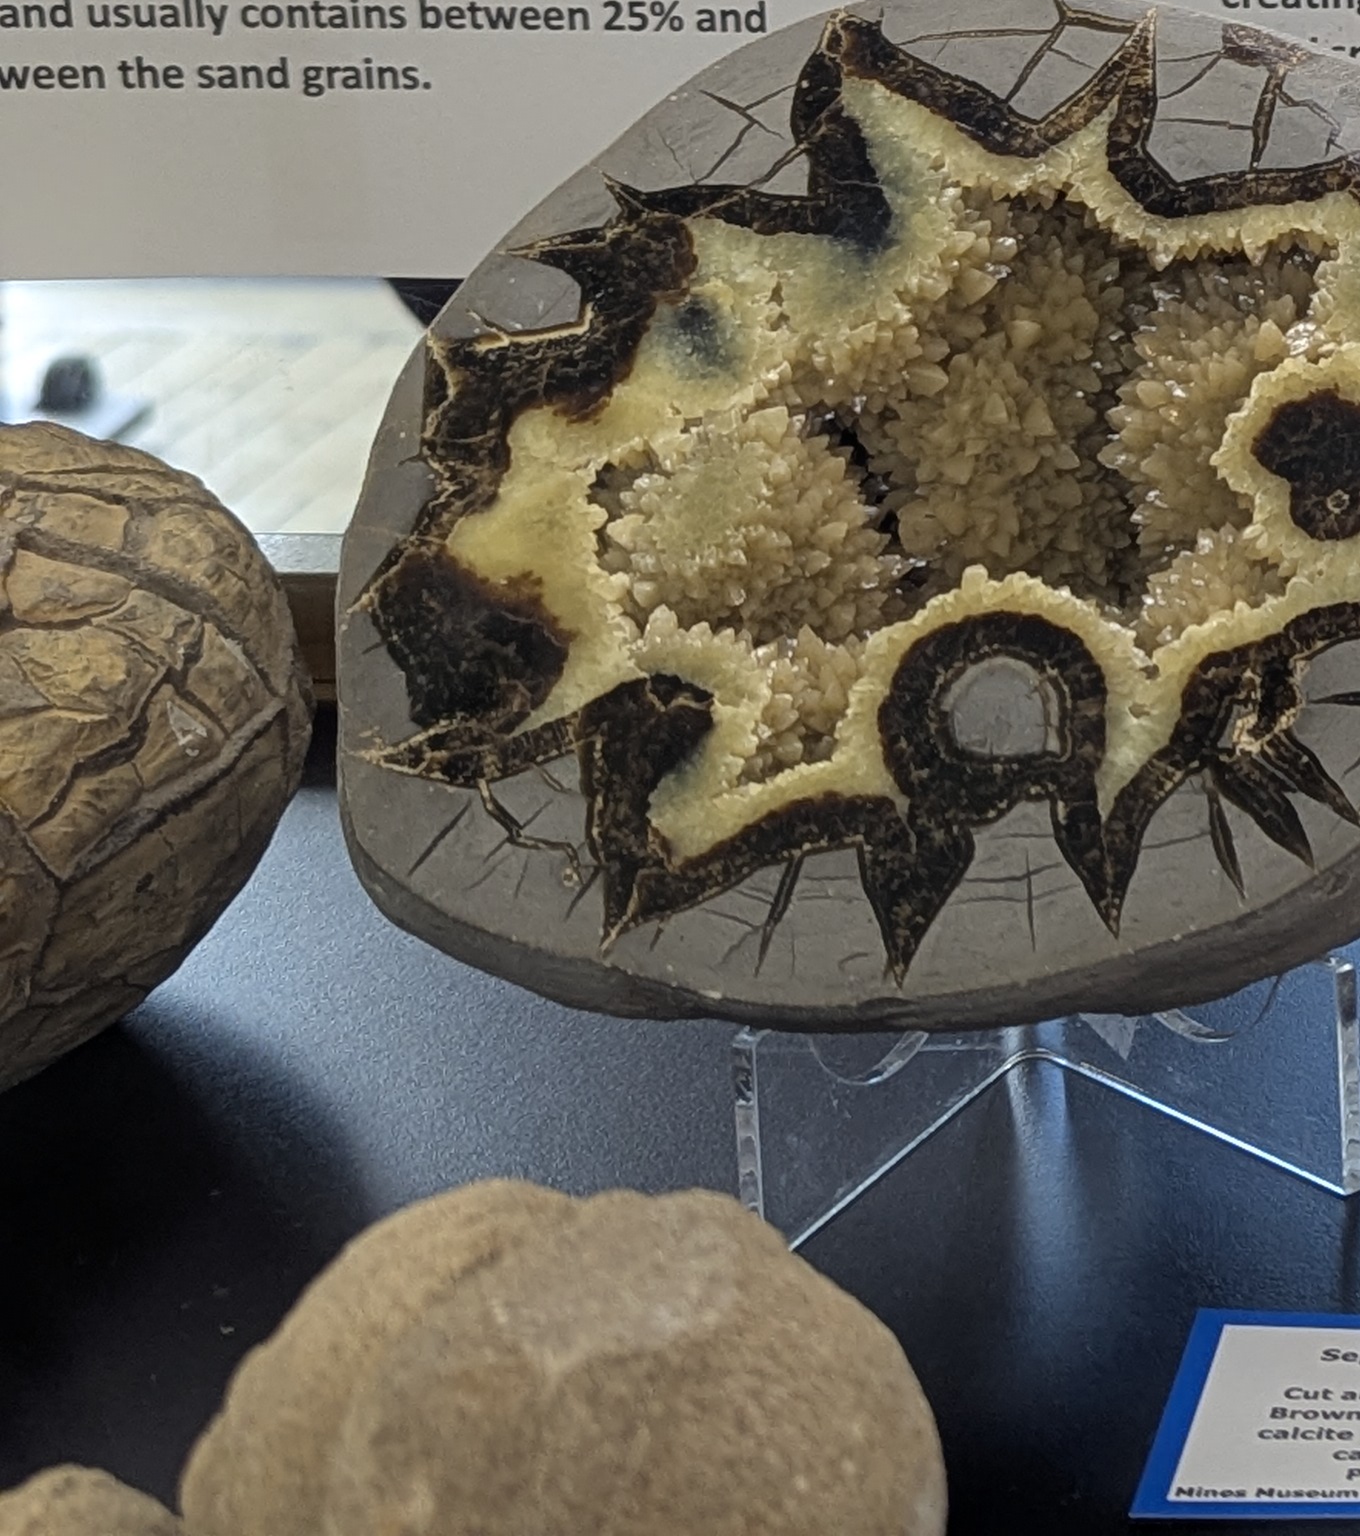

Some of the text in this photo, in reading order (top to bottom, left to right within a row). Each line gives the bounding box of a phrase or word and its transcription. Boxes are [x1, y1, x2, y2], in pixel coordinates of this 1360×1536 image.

[603, 0, 684, 31] 25%
[695, 0, 767, 33] and
[1284, 1388, 1333, 1400] Cut
[1258, 1427, 1353, 1440] calcite
[1176, 1487, 1246, 1498] Mines
[1256, 1488, 1358, 1498] Museum
